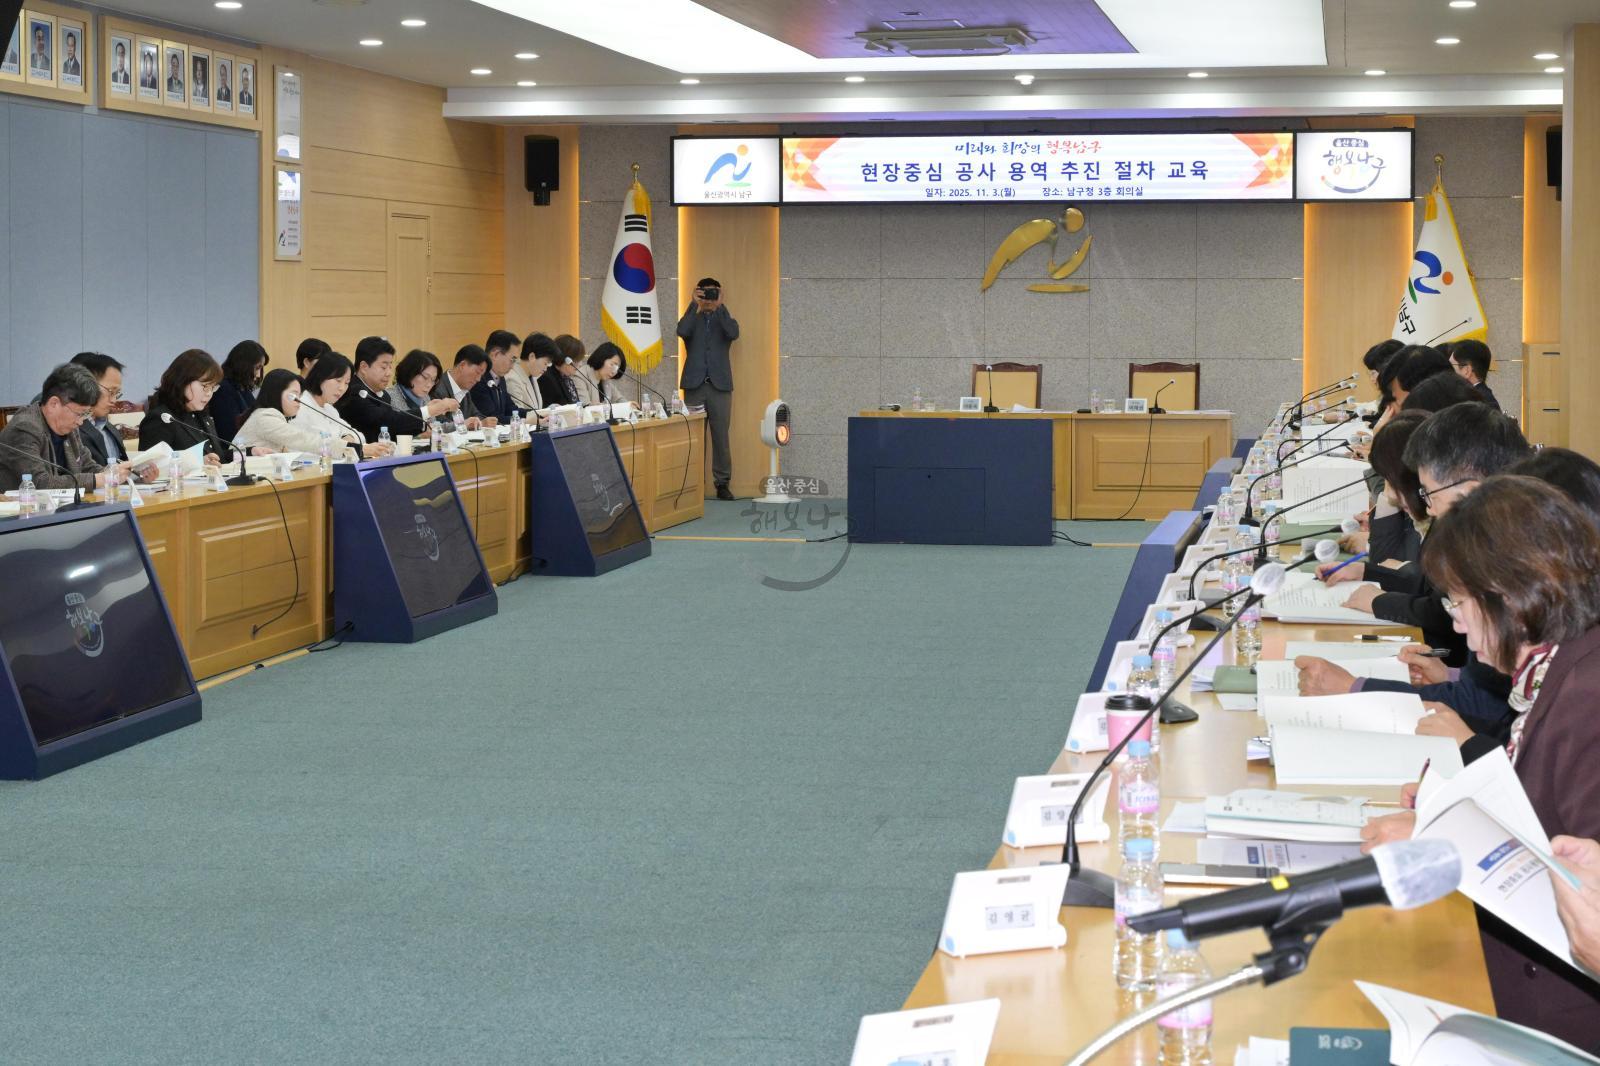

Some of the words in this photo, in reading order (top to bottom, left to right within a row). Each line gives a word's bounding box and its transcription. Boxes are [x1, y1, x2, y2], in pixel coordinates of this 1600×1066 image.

[861, 162, 942, 182] 현장중심
[956, 162, 996, 182] 공사
[1008, 161, 1047, 182] 용역
[1061, 161, 1100, 181] 추진
[1114, 161, 1155, 181] 절차
[1167, 160, 1209, 180] 교육
[704, 190, 737, 199] 울산광역시
[739, 190, 752, 199] 남구
[925, 188, 946, 198] 일자:
[949, 188, 972, 198] 2025.
[976, 188, 989, 198] 11.
[1042, 187, 1063, 197] 장소:
[1067, 187, 1094, 197] 남구청
[1098, 187, 1112, 197] 3층
[1115, 186, 1144, 197] 회의실
